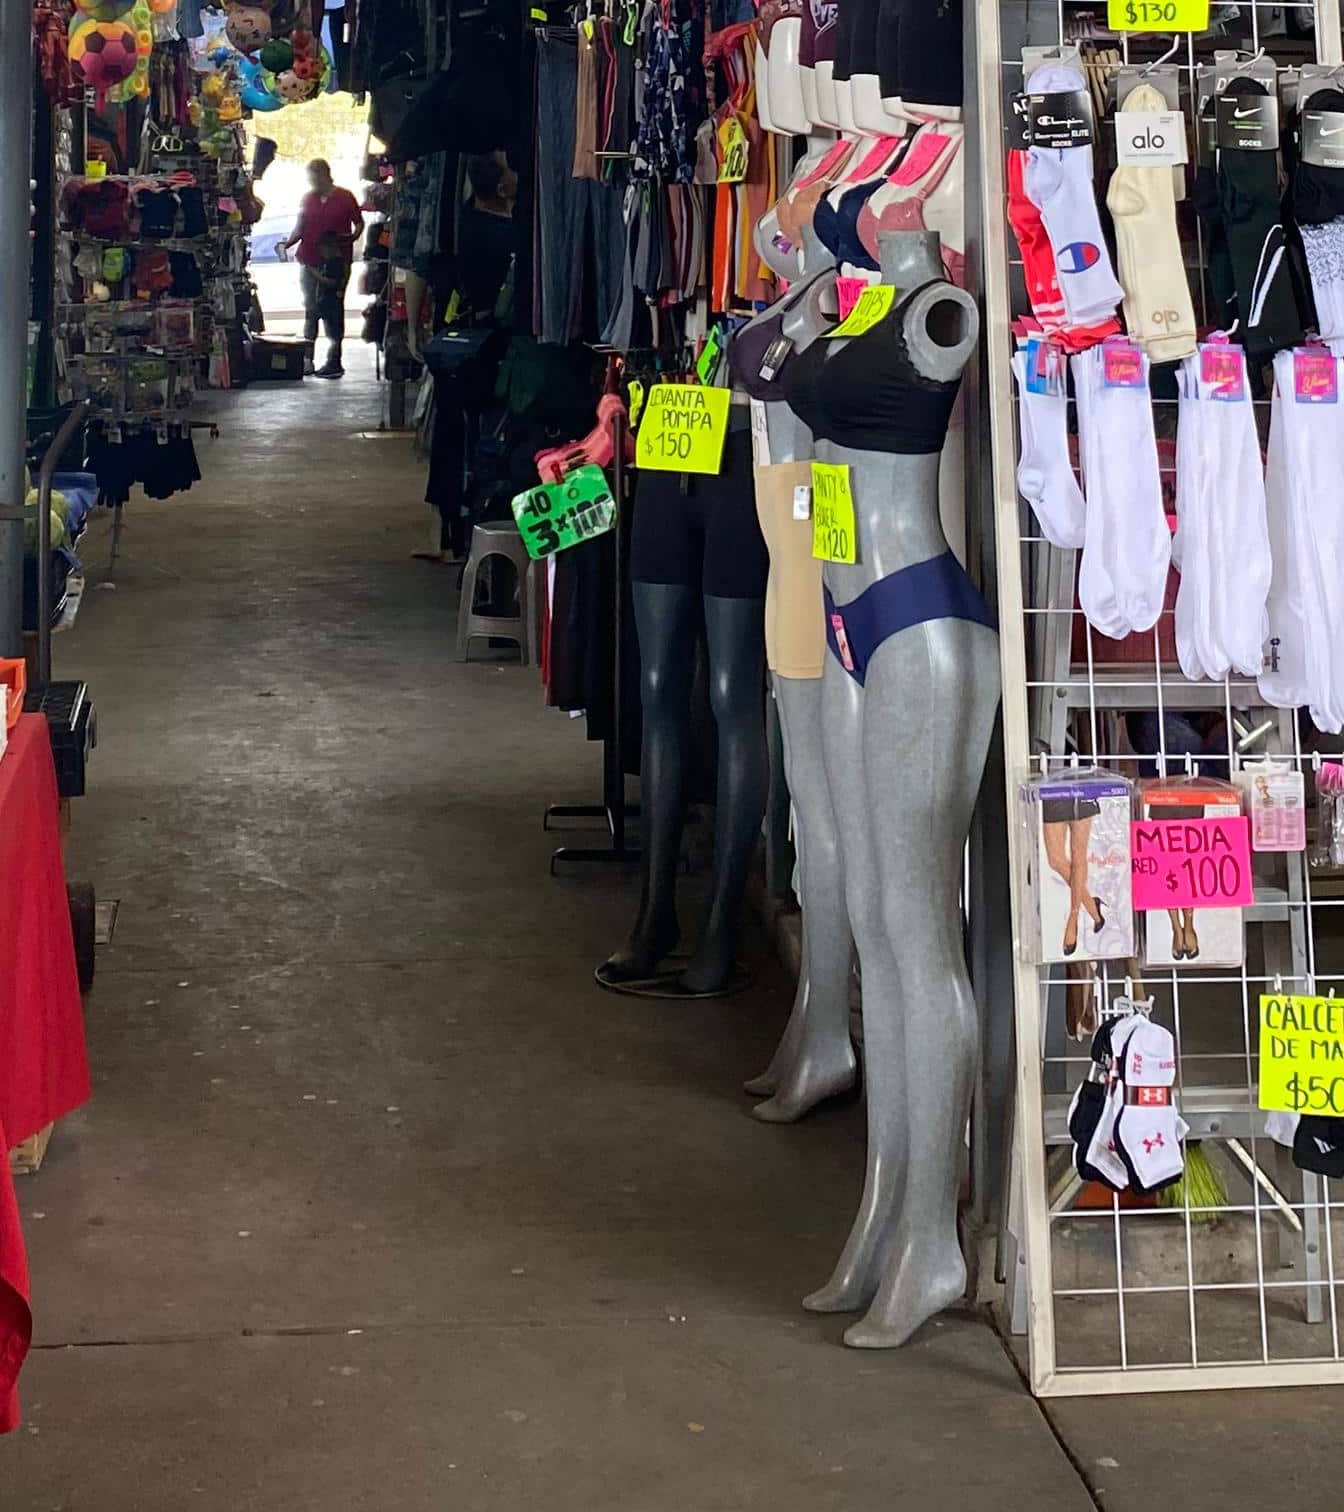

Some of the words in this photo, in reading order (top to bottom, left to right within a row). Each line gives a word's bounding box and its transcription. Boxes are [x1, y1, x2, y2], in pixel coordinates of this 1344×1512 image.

[1125, 0, 1177, 24] $130
[1132, 126, 1165, 149] alo
[650, 388, 705, 408] LEVANTA
[662, 409, 712, 430] POMPA
[645, 432, 692, 459] $150
[1136, 825, 1233, 854] MEDIA
[1132, 856, 1158, 875] RED
[1165, 854, 1241, 899] $100
[1271, 1035, 1298, 1058] DE
